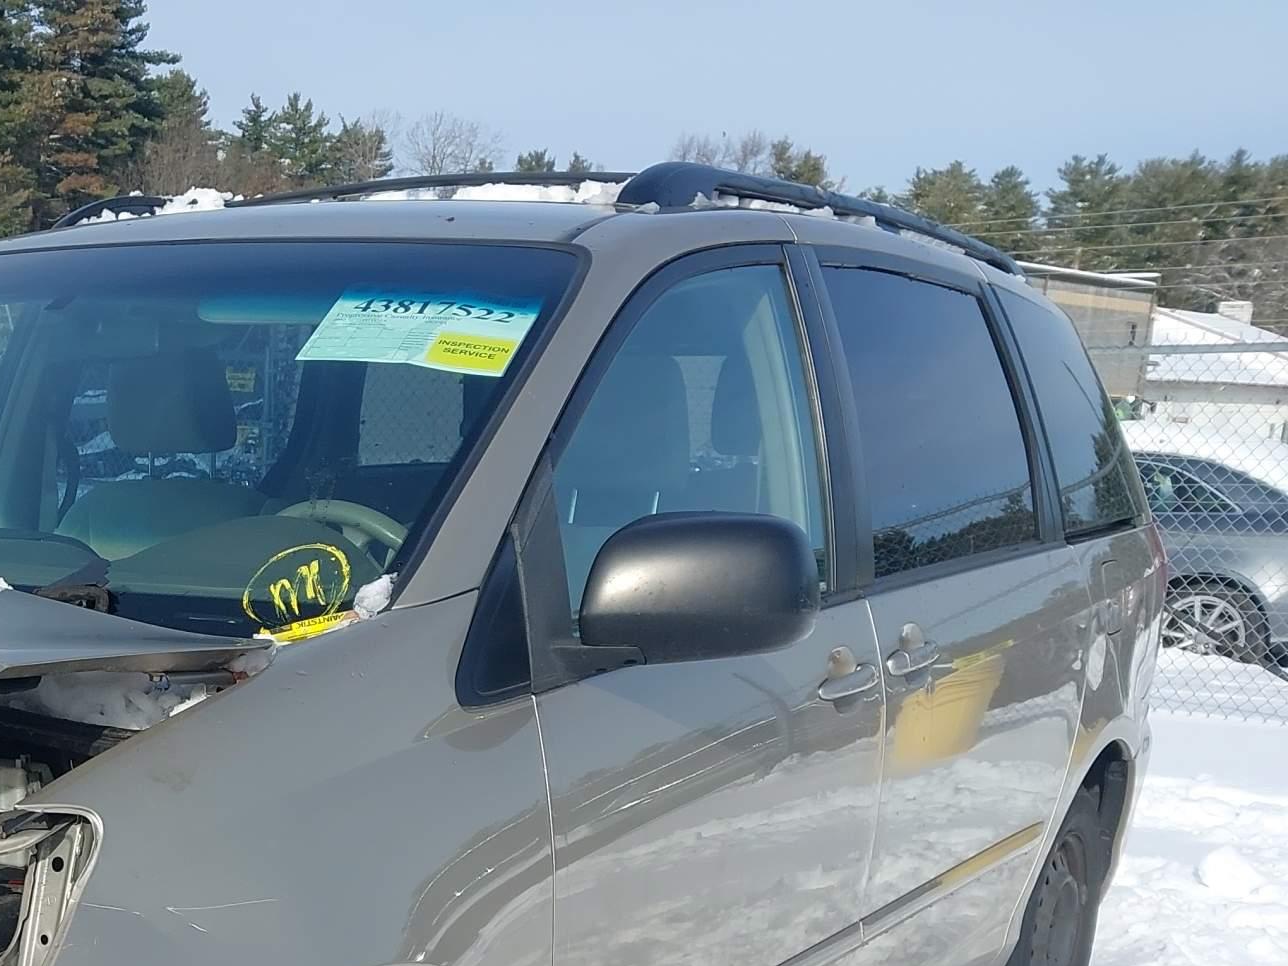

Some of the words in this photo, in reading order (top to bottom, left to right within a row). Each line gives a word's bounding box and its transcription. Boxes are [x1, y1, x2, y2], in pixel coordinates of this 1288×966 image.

[354, 298, 516, 323] 43817522
[438, 339, 510, 353] INSPECTION
[442, 347, 497, 360] SERVICE
